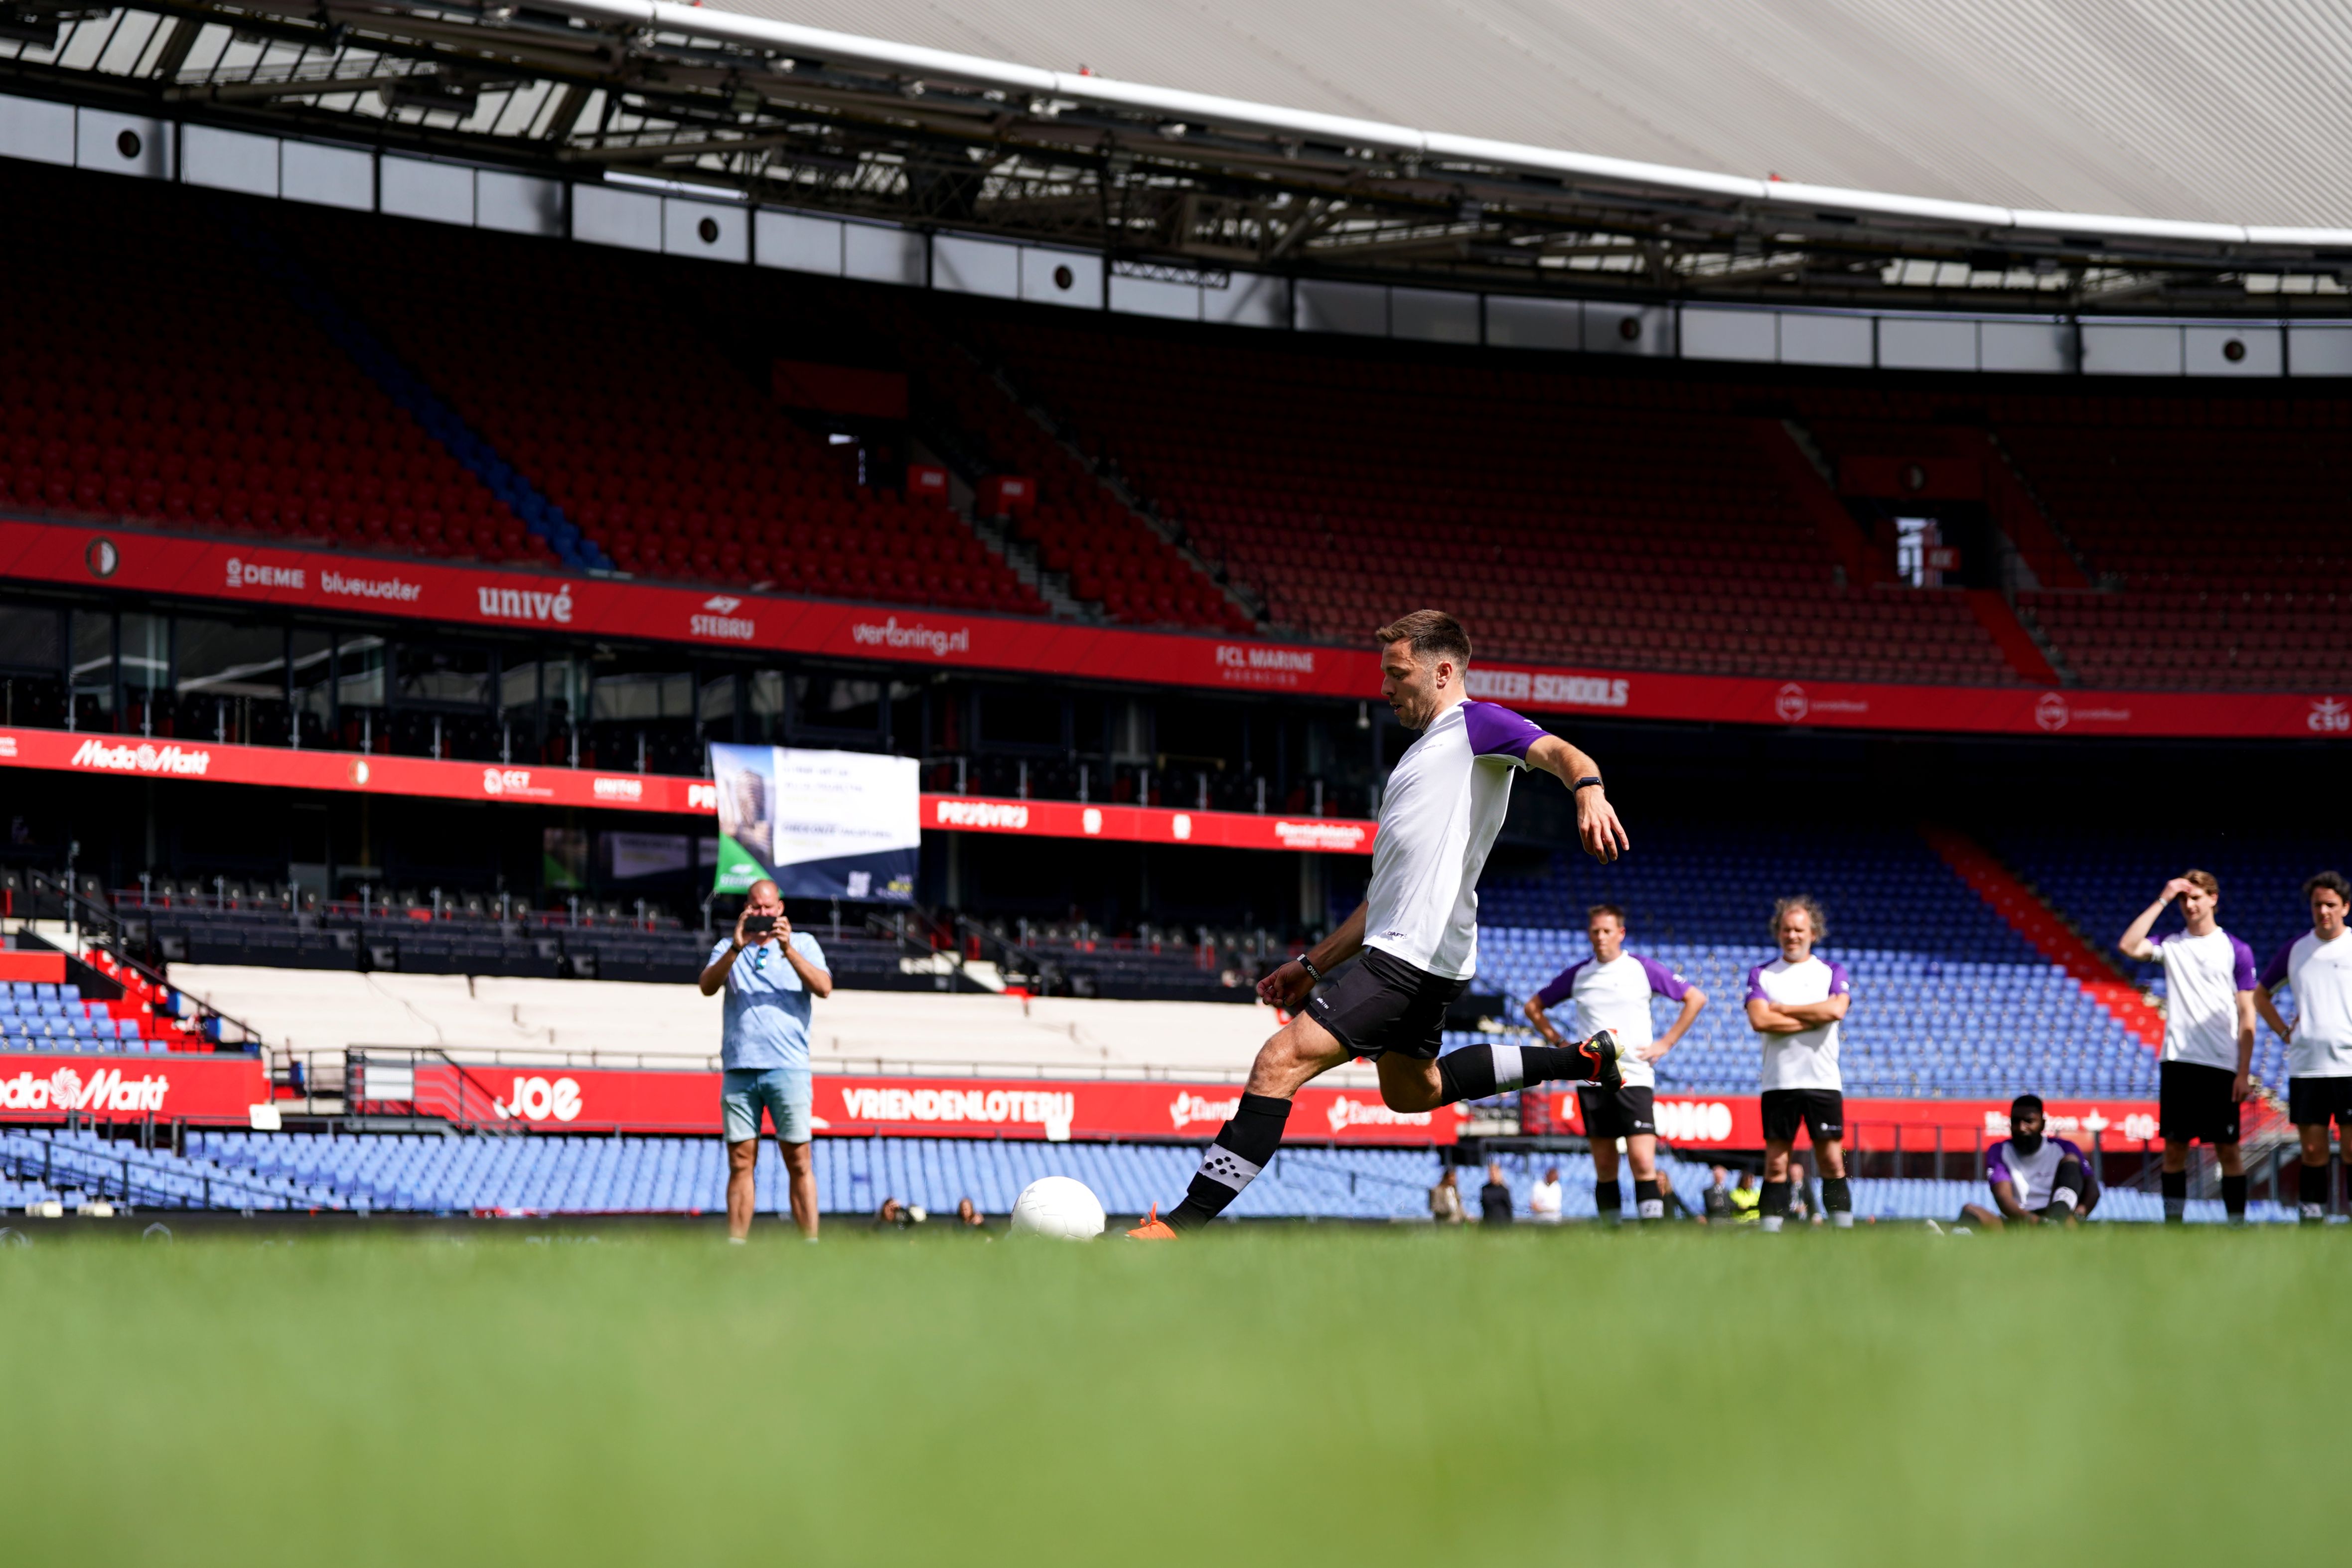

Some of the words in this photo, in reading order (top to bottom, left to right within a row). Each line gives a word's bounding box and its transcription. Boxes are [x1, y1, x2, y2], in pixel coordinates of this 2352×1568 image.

[244, 564, 305, 589] DEME
[321, 570, 422, 601] bluewater
[478, 583, 572, 623] univé
[690, 614, 754, 640] STEBRU
[853, 616, 969, 656] verloning.nl
[1216, 646, 1246, 667] FCL
[1249, 648, 1314, 673] MARINE
[1533, 674, 1629, 707] SCHOOLS
[2307, 712, 2350, 731] CSU
[75, 1068, 169, 1111] Markt
